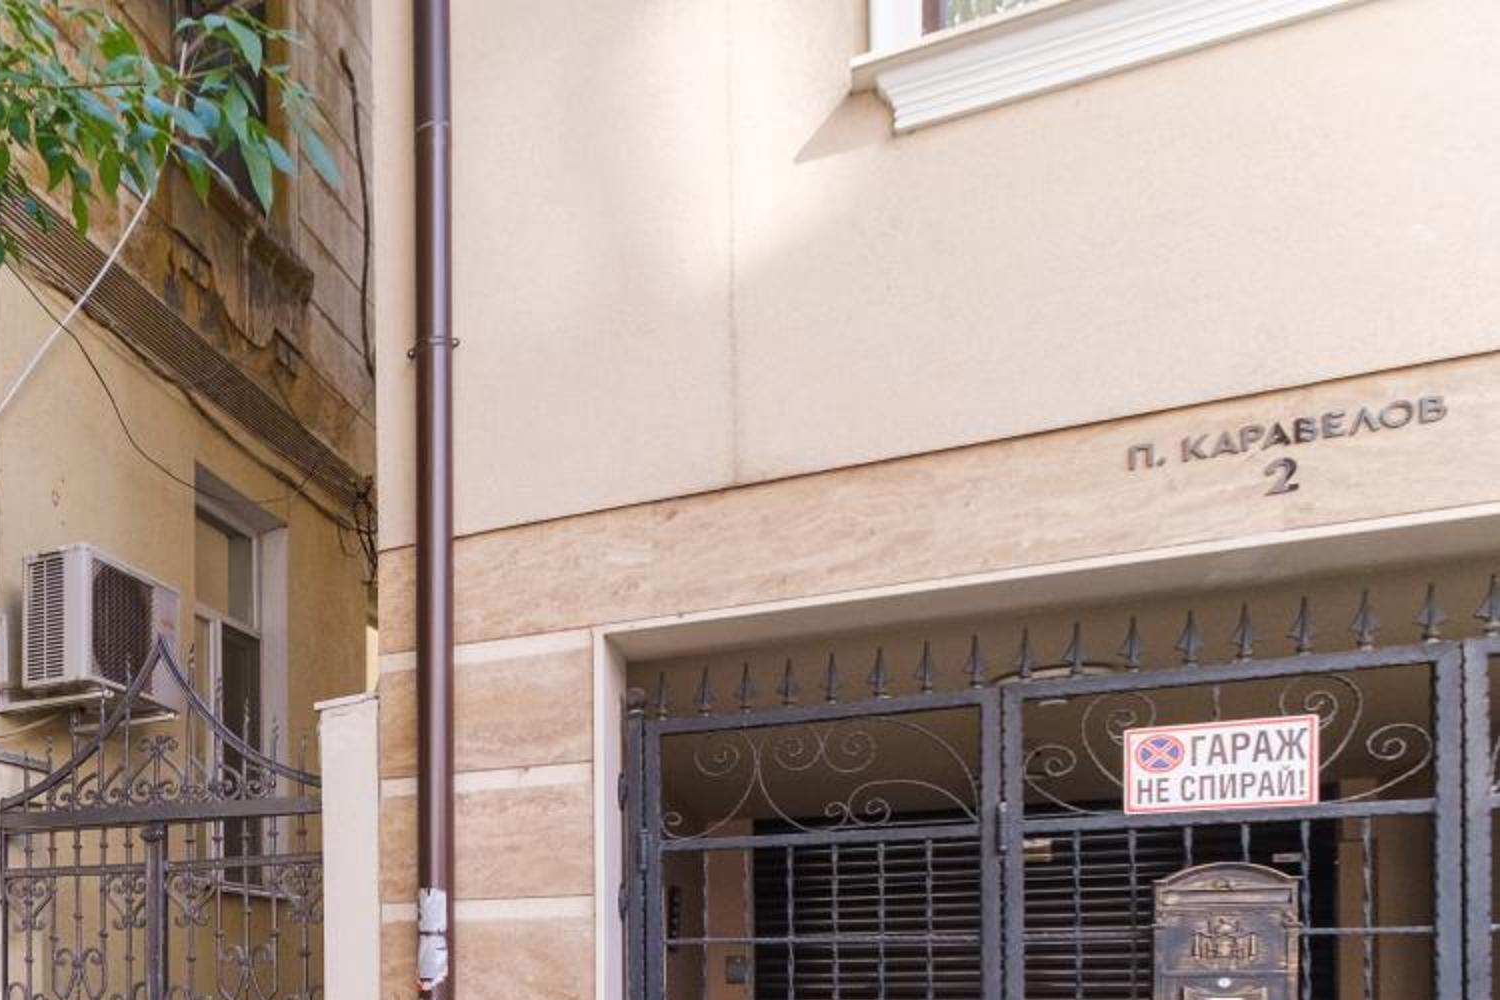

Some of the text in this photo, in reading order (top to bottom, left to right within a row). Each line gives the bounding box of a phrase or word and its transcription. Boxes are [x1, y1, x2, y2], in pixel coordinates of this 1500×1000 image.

[1126, 395, 1448, 472] П. КАРАВЕЛОВ
[1264, 457, 1300, 497] 2
[1190, 727, 1308, 767] ГАРАЖ
[1137, 765, 1306, 804] НЕ СПИРАЙ!
